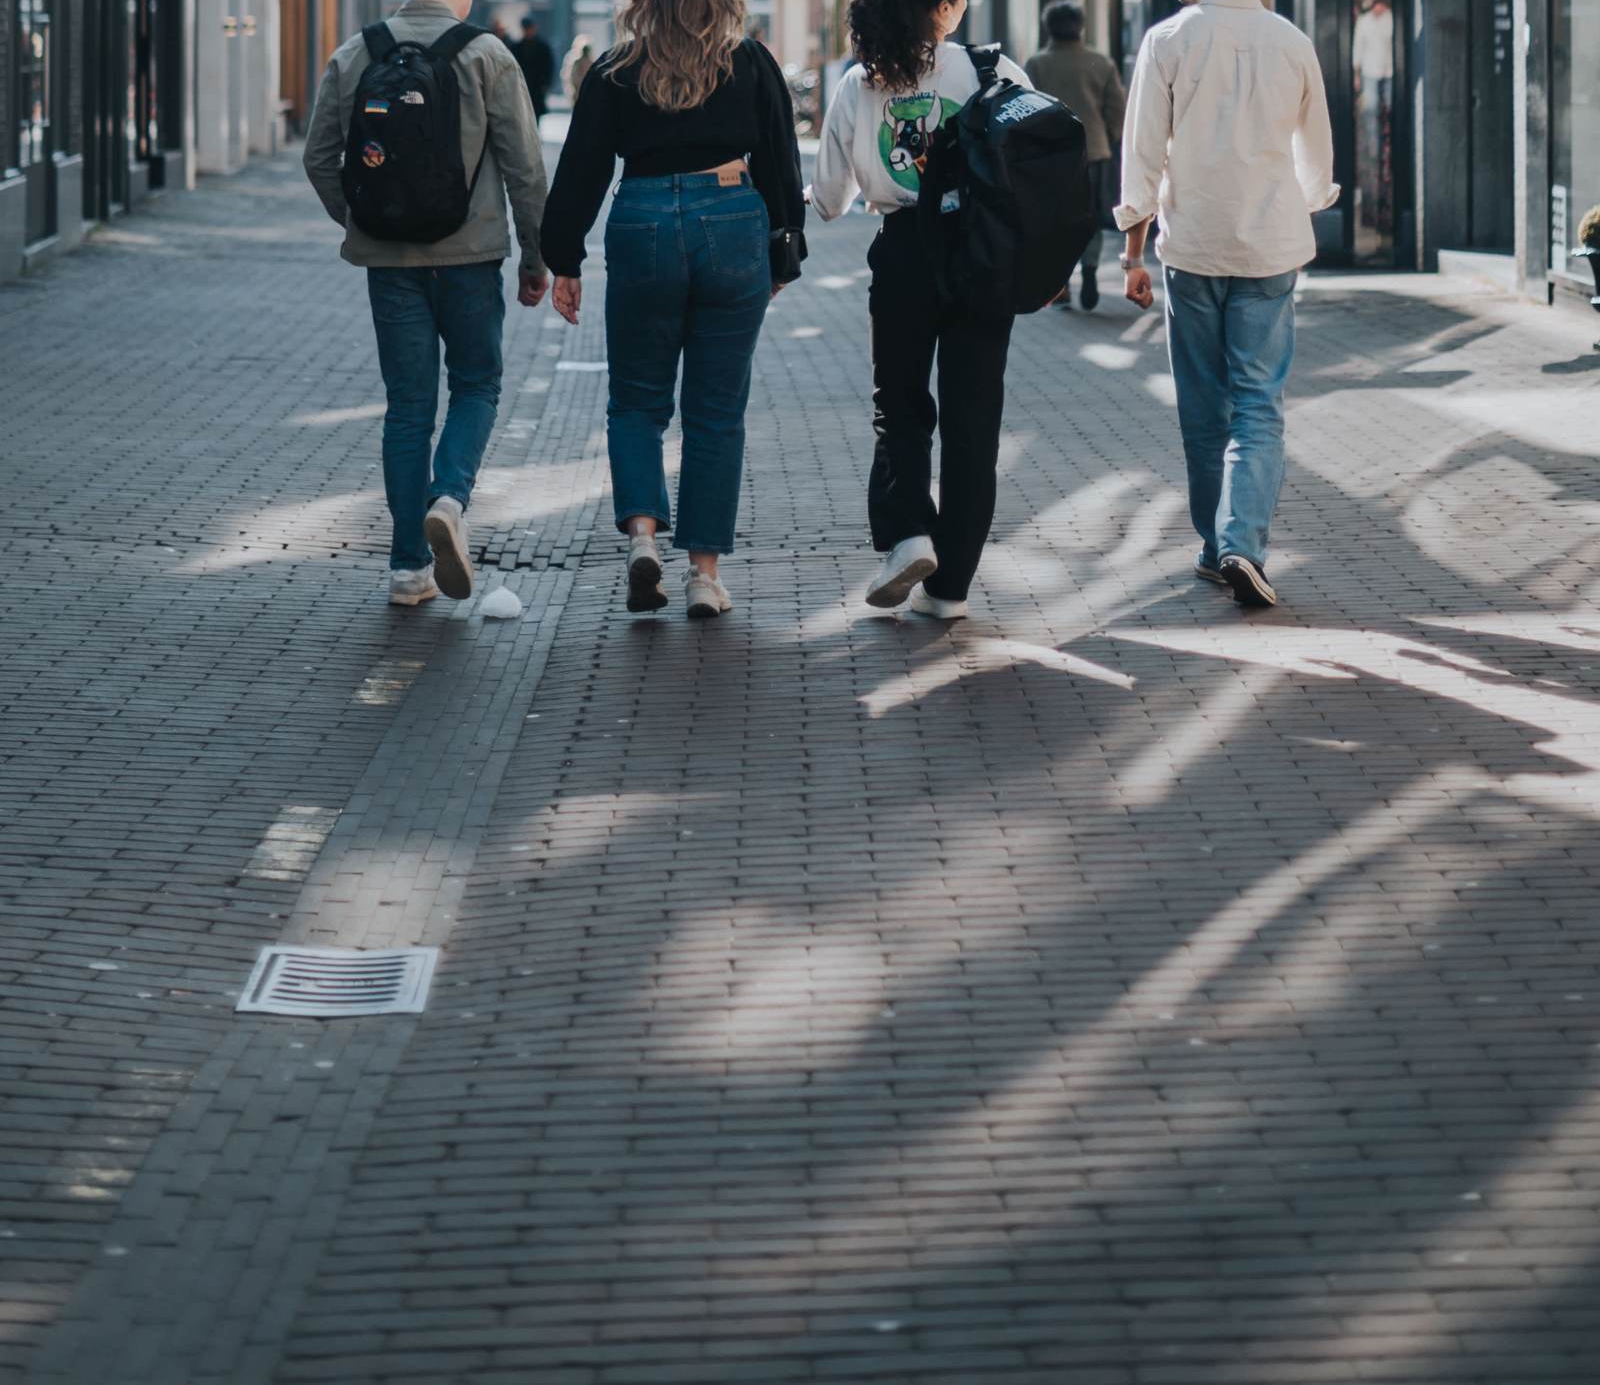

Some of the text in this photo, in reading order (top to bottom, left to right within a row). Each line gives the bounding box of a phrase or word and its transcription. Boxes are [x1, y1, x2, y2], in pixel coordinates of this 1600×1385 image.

[995, 101, 1033, 123] NORTH
[1000, 97, 1024, 111] THE
[1010, 105, 1038, 122] FACE
